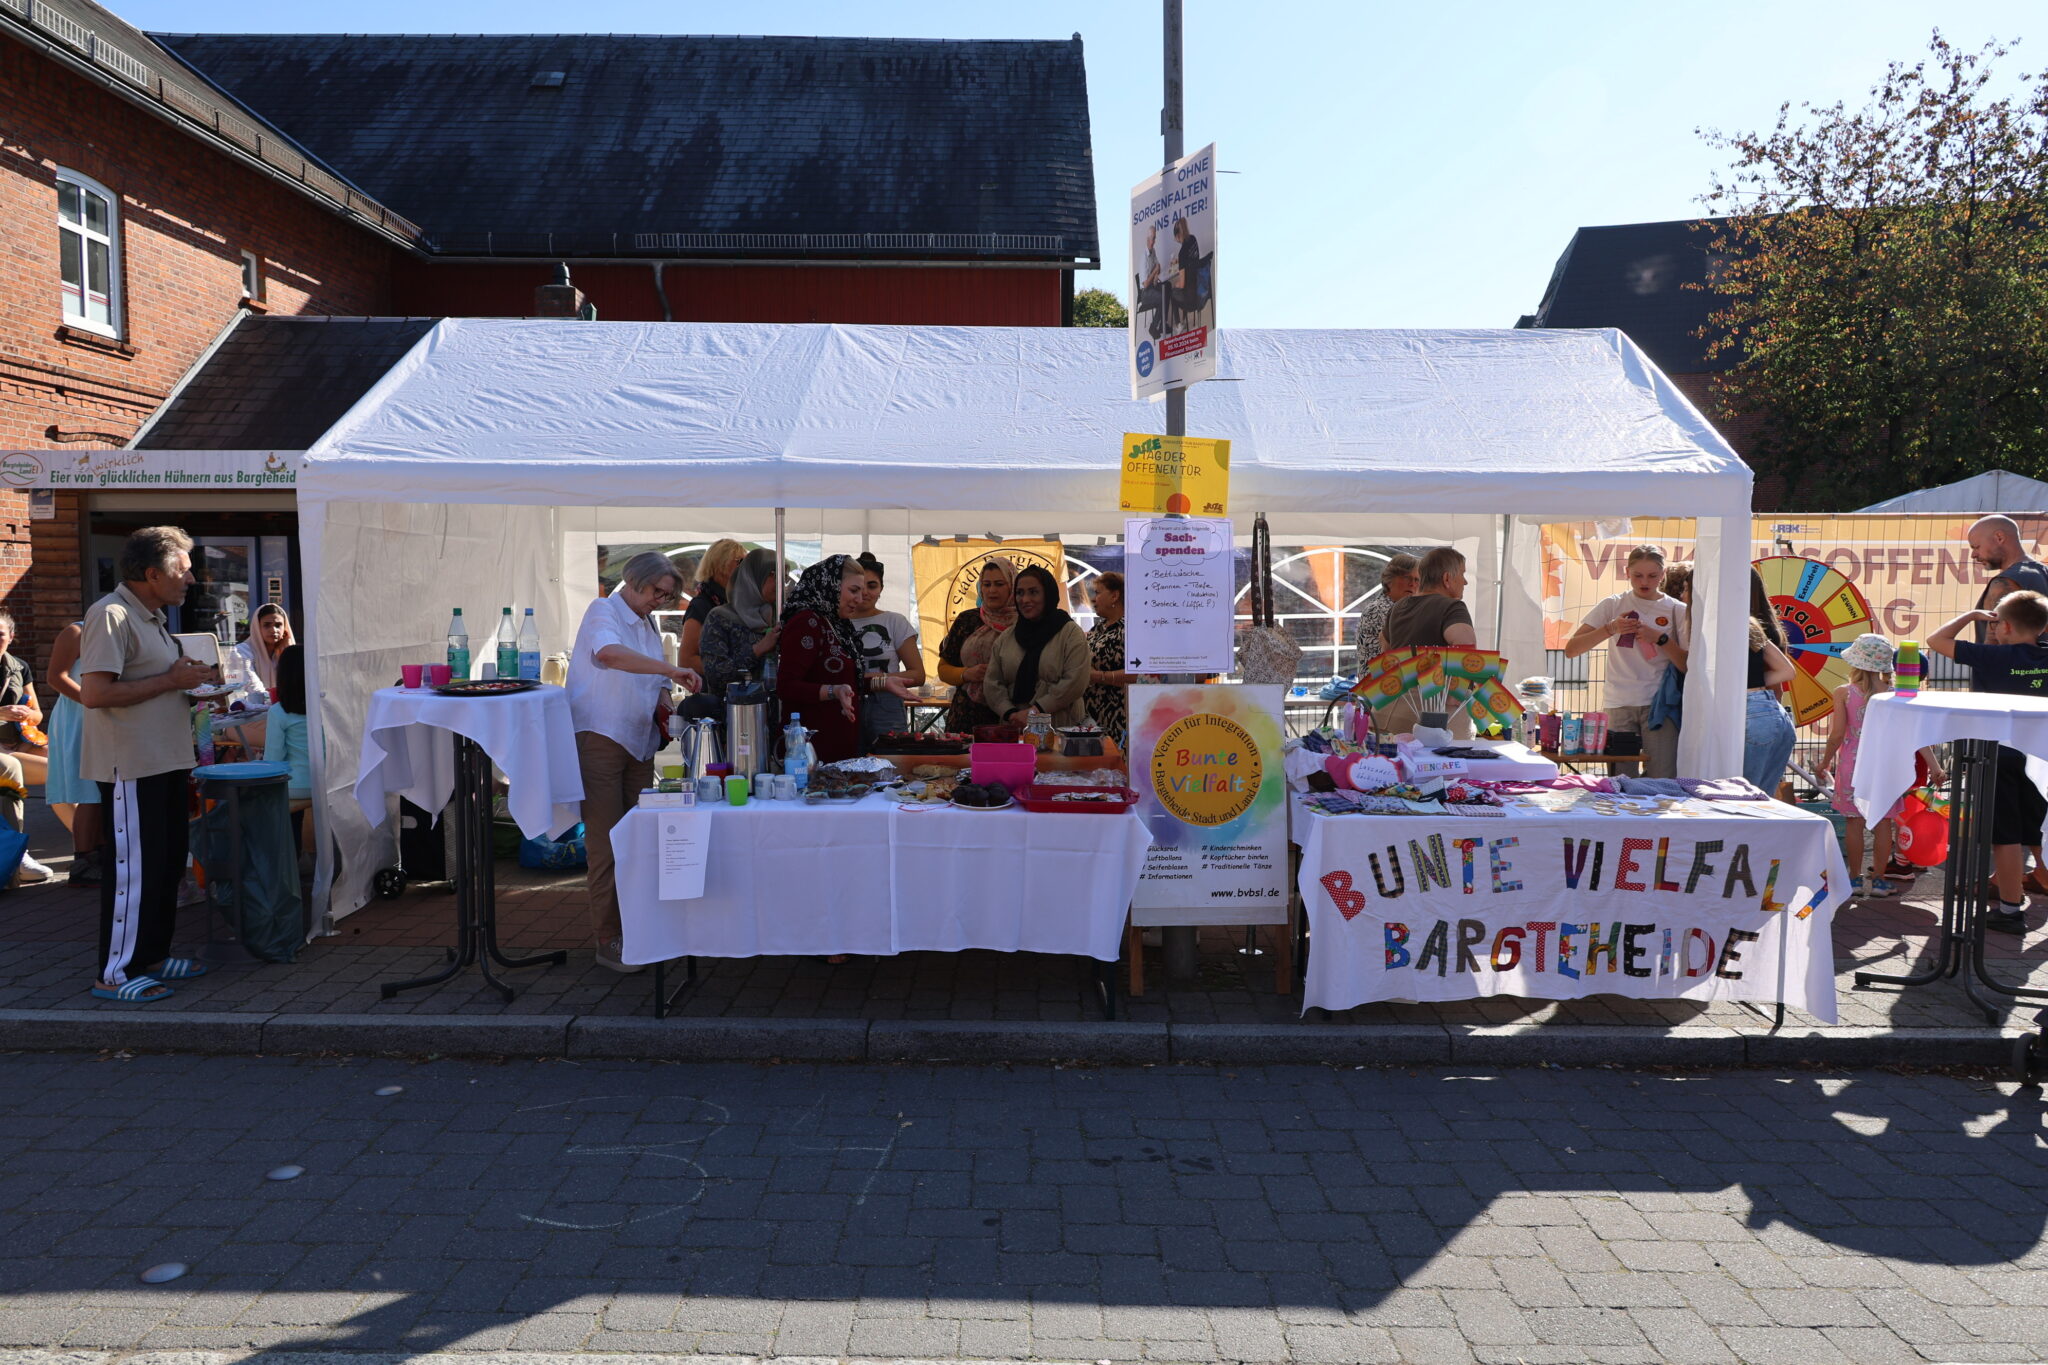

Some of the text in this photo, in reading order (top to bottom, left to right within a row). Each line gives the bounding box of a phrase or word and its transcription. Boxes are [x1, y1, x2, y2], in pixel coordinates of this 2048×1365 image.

[1178, 157, 1209, 182] OHNE
[1133, 177, 1208, 225] SORGENFALTEN
[1154, 215, 1169, 231] INS
[96, 452, 144, 470] wirklich
[1164, 451, 1187, 462] DER
[1127, 462, 1178, 475] OFFENEN
[50, 470, 71, 483] Eier
[74, 472, 93, 483] von
[100, 470, 160, 486] glücklichen
[164, 470, 211, 483] Hühnern
[214, 473, 233, 483] aus
[1164, 532, 1197, 542] Sach-
[1155, 545, 1206, 557] spenden
[953, 566, 981, 606] Stadt
[1840, 593, 1858, 619] GEWINN
[1801, 697, 1829, 716] GEWINN
[1155, 714, 1259, 758] Verein für Integration
[1176, 749, 1239, 767] Bunte
[1170, 773, 1246, 793] Vielfalt
[1155, 770, 1191, 817] Bargteheide
[1191, 811, 1217, 824] Stadt
[1219, 808, 1237, 822] und
[1235, 788, 1257, 812] Land
[1210, 854, 1245, 862] Kopftücher
[1319, 832, 1525, 921] BUNTE
[1211, 888, 1280, 898] www.bvbsl.de
[1383, 918, 1760, 981] BARGTEHEIDE
